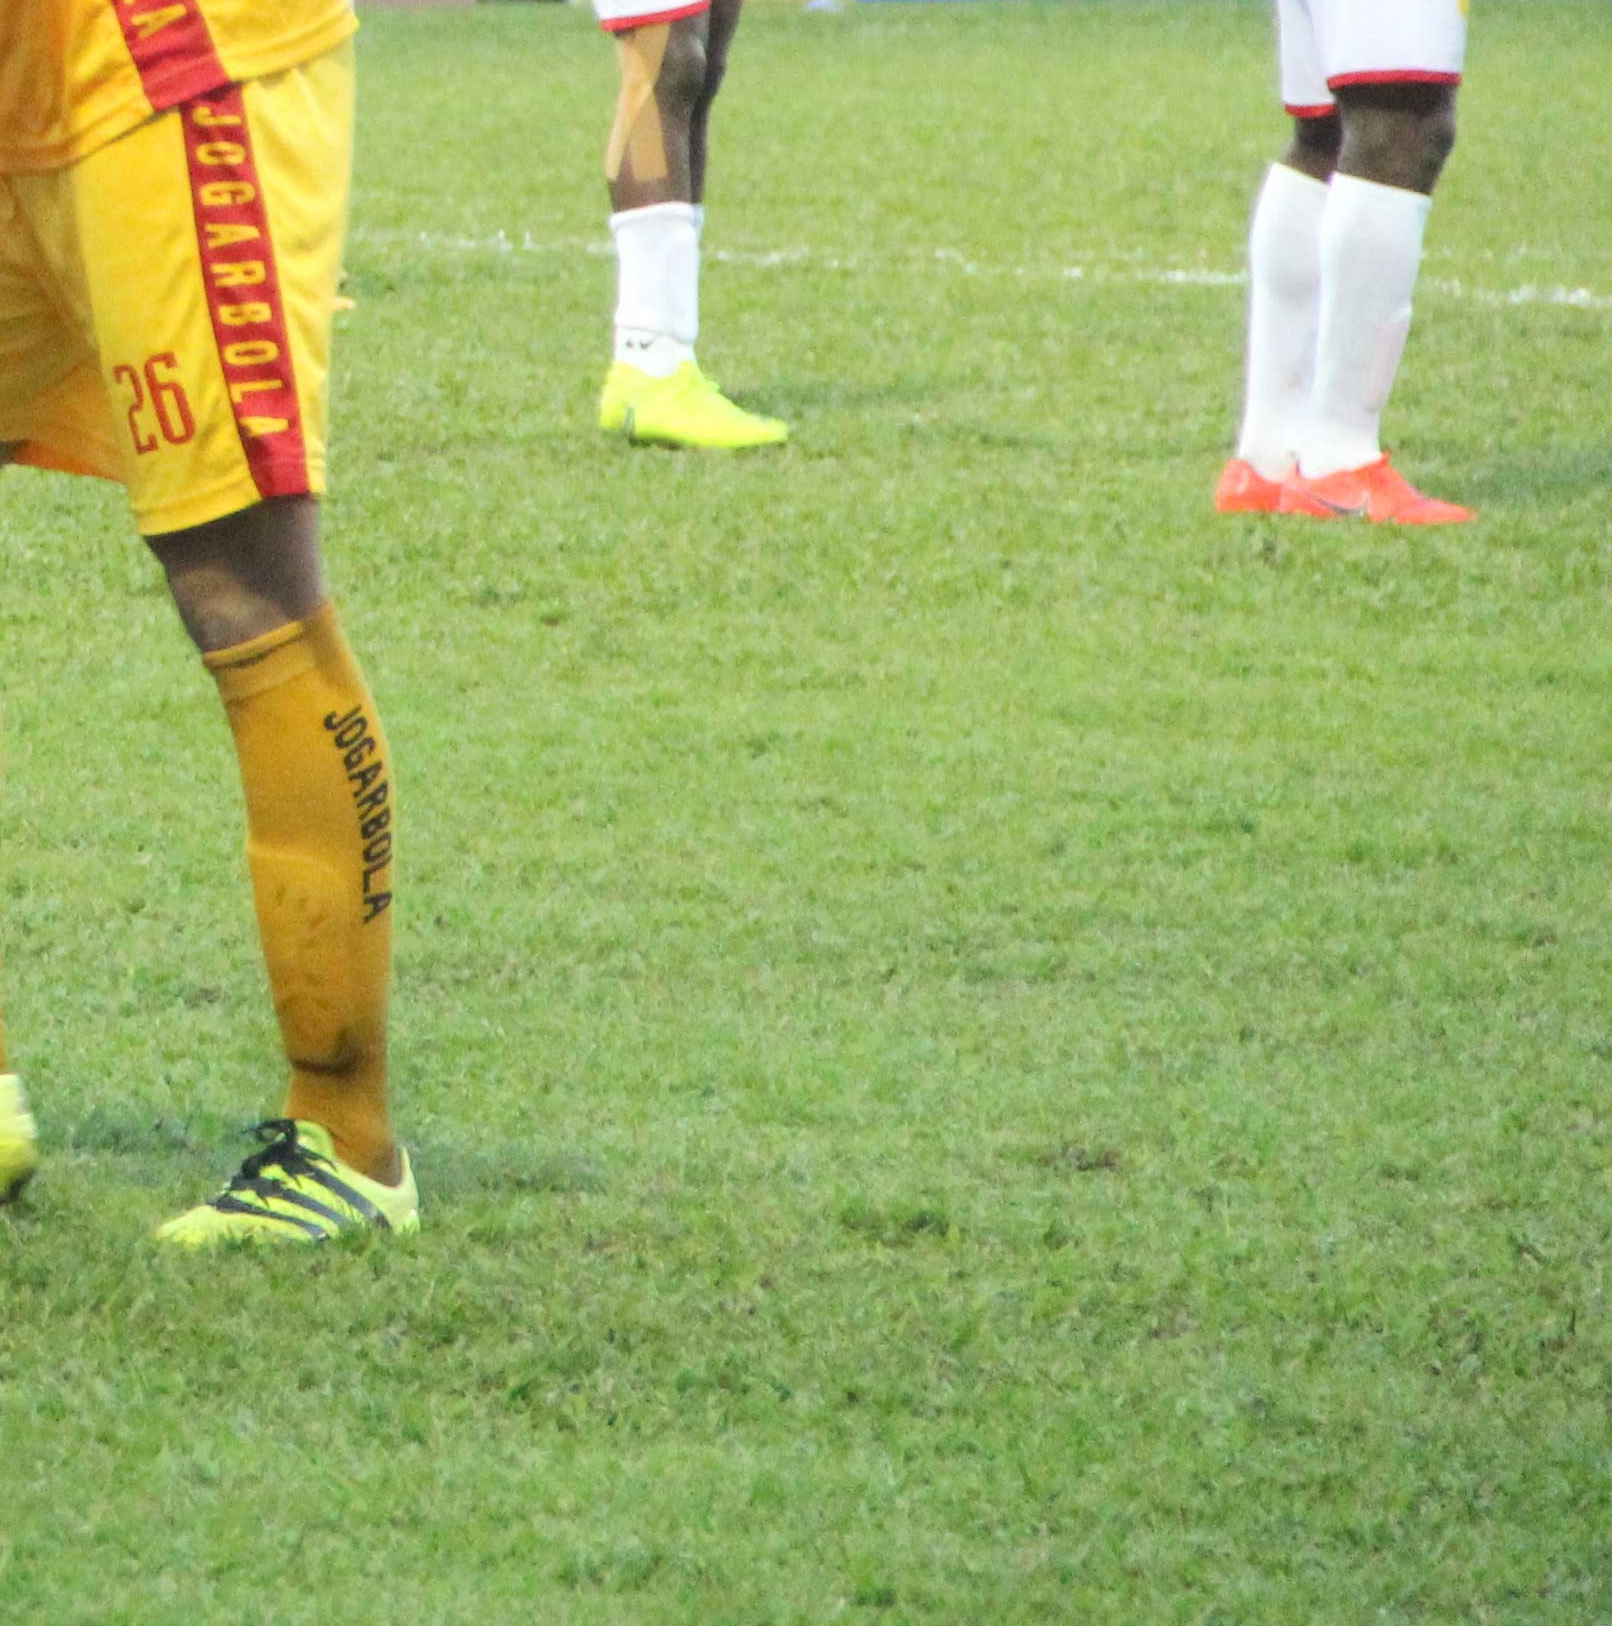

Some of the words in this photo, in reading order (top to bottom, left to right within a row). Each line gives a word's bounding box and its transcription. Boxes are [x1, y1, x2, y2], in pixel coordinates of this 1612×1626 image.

[192, 105, 290, 440] JOGARBOLA
[114, 351, 197, 455] 26
[323, 705, 393, 925] JOGARBOLA
